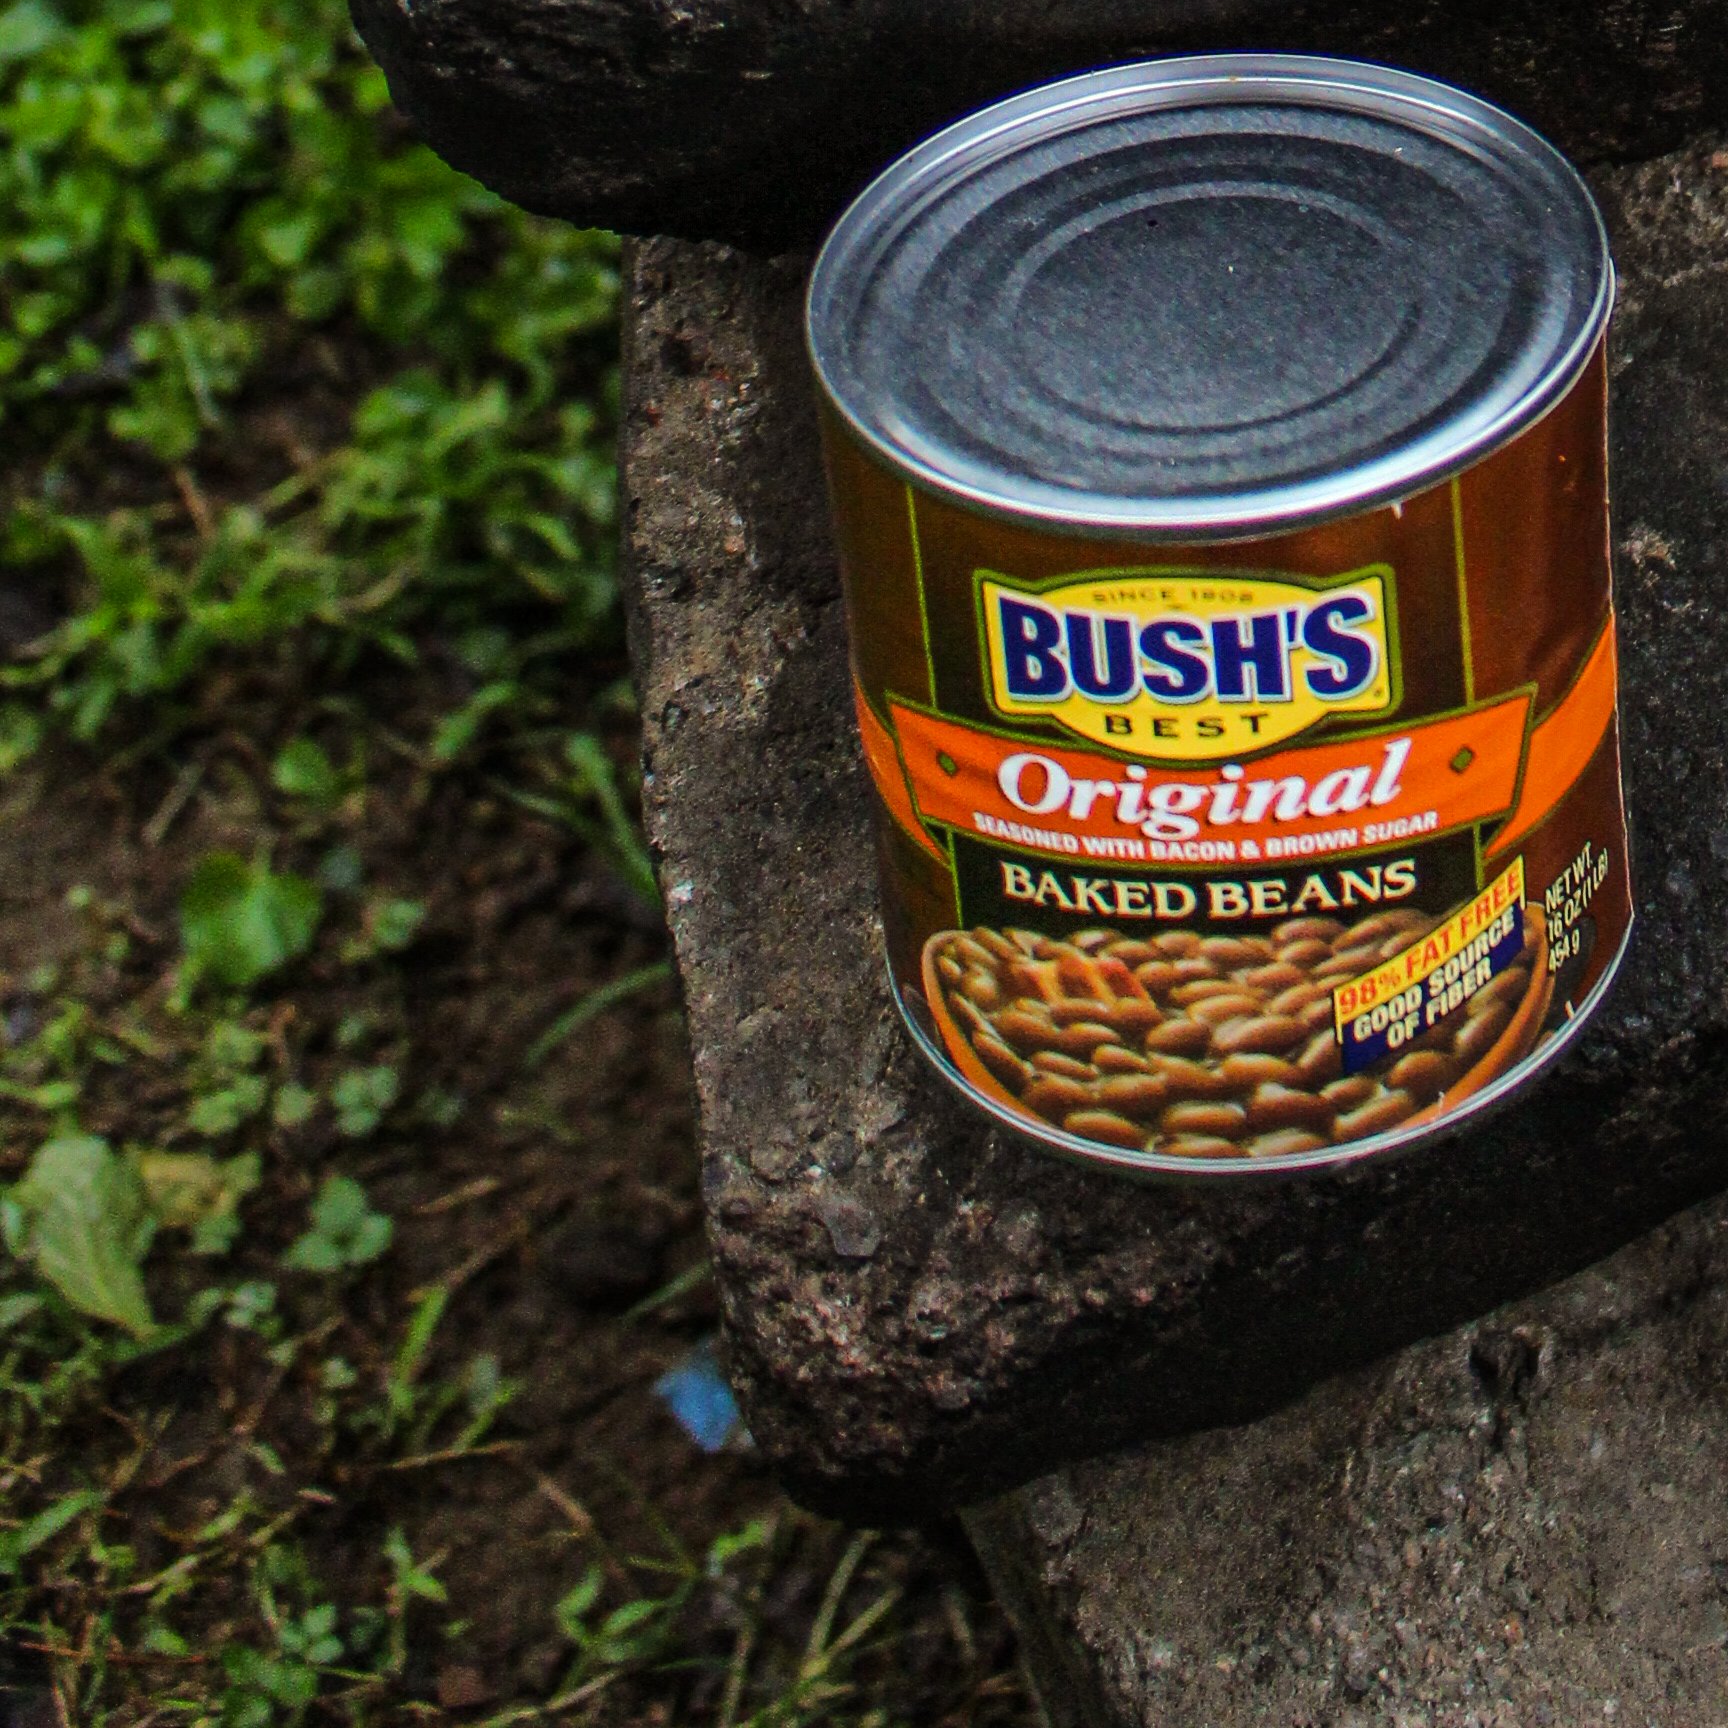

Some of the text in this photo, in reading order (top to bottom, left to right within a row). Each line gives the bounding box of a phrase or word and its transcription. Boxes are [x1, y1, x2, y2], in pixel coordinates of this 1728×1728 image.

[998, 592, 1374, 701] BUSH'S
[1105, 713, 1270, 738] BEST
[998, 737, 1412, 841] Original
[972, 810, 1439, 862] SEASONED WITH BACON & BROWN SUGAR
[1000, 858, 1418, 920] BAKED BEANS
[1545, 867, 1572, 913] NET
[1548, 911, 1563, 943] 16
[1564, 887, 1582, 927] OZ
[1339, 865, 1521, 1016] 98% FAT FREE
[1548, 934, 1571, 973] 454
[1353, 906, 1515, 1042] GOOD SOURCE
[1386, 956, 1493, 1049] OF FIBER
